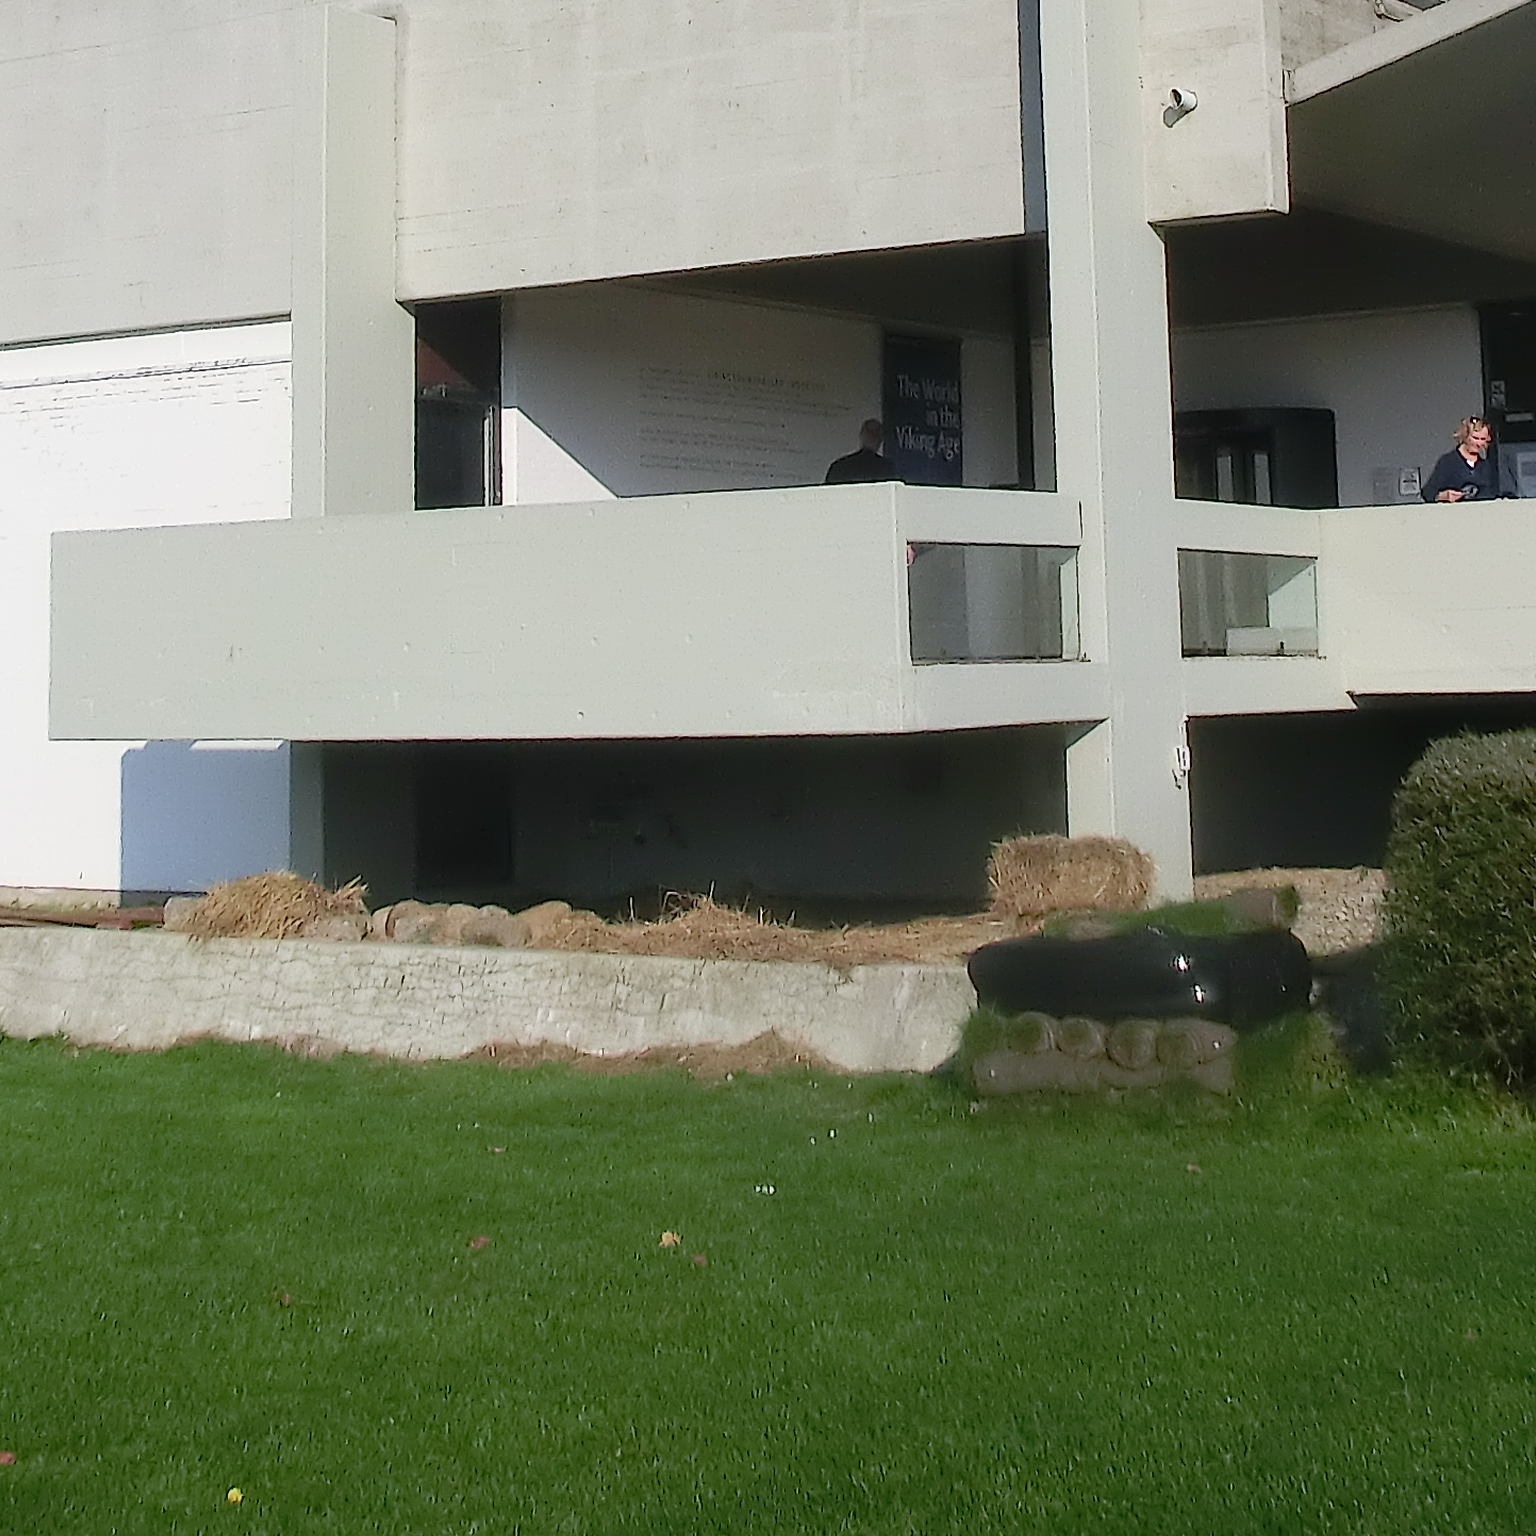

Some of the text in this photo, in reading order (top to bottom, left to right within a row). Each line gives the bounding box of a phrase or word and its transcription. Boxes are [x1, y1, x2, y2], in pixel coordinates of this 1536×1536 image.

[896, 374, 959, 404] The World
[925, 400, 959, 429] in the
[896, 425, 959, 460] Viking Age
